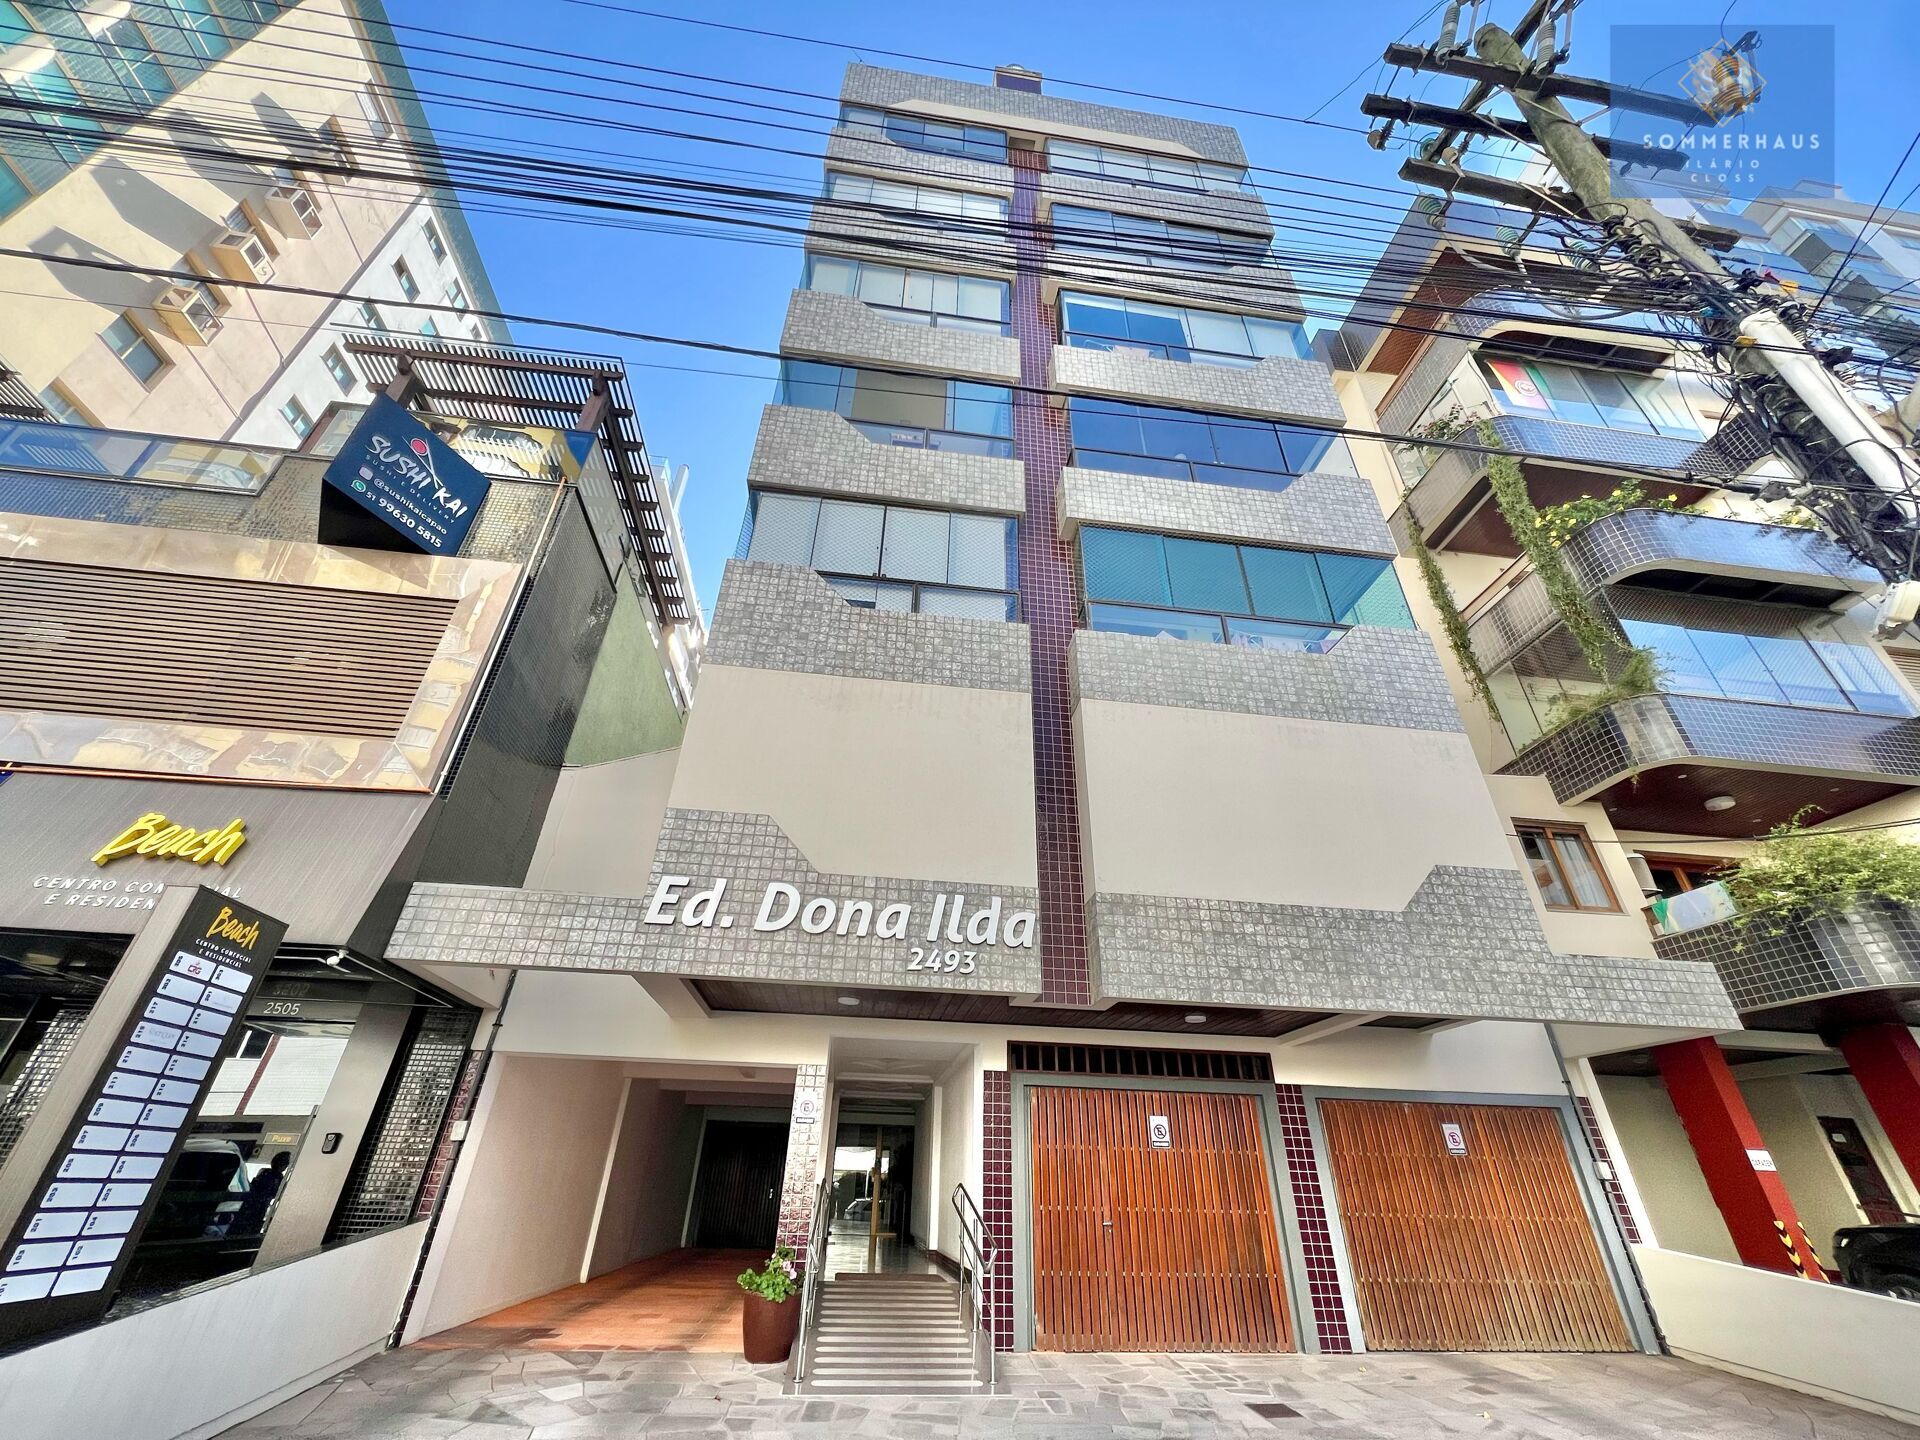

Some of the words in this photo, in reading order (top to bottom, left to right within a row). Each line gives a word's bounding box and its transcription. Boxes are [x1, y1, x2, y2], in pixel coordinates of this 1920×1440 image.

[365, 436, 432, 489] SUSHI
[432, 487, 468, 518] KAI
[365, 454, 397, 480] SUSHI
[410, 488, 455, 523] DELIVERY
[365, 491, 376, 501] 51
[378, 498, 415, 529] 99630
[416, 525, 443, 549] 5815
[374, 478, 448, 535] @sushikaicapao
[91, 812, 246, 866] Beach
[33, 876, 117, 892] CENTRO
[44, 893, 60, 905] E
[206, 906, 260, 950] Beach
[643, 875, 734, 929] Ed.
[753, 882, 912, 940] Dona
[926, 893, 1037, 948] Ilda
[195, 938, 219, 951] CENTRO
[221, 947, 252, 964] COMERCIAL
[205, 950, 242, 968] RESIDENCIAL
[907, 947, 977, 974] 2493
[263, 1002, 301, 1015] 2505
